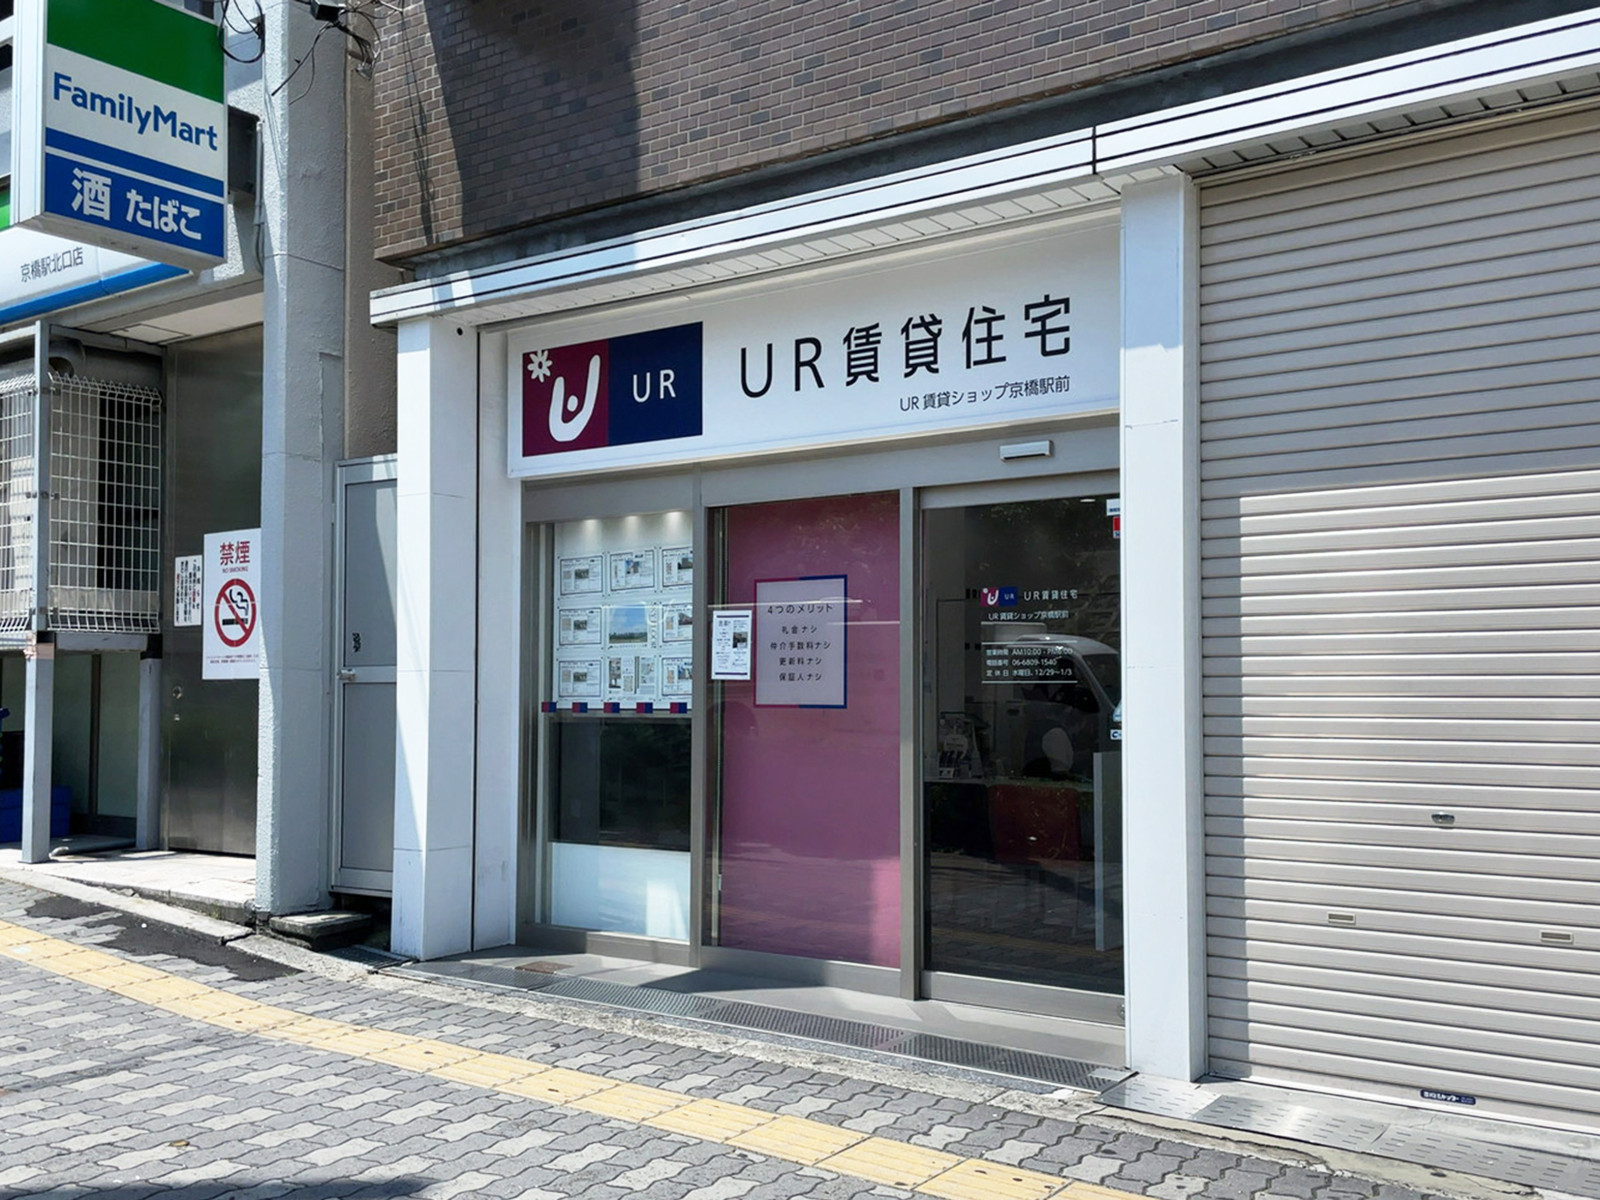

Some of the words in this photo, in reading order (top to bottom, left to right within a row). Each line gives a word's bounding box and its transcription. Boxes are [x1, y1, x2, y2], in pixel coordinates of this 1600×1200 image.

[53, 72, 218, 151] FamilyMart
[71, 167, 112, 221] 酒
[126, 188, 202, 241] たばこ
[20, 246, 84, 283] 京橋駅北口店
[632, 369, 676, 403] UR
[219, 540, 250, 566] 禁煙
[768, 603, 833, 615] 4つのメリット
[781, 625, 818, 635] 礼金ナシ
[779, 657, 823, 666] 更新料ナシ
[779, 672, 823, 682] 保証人ナシ
